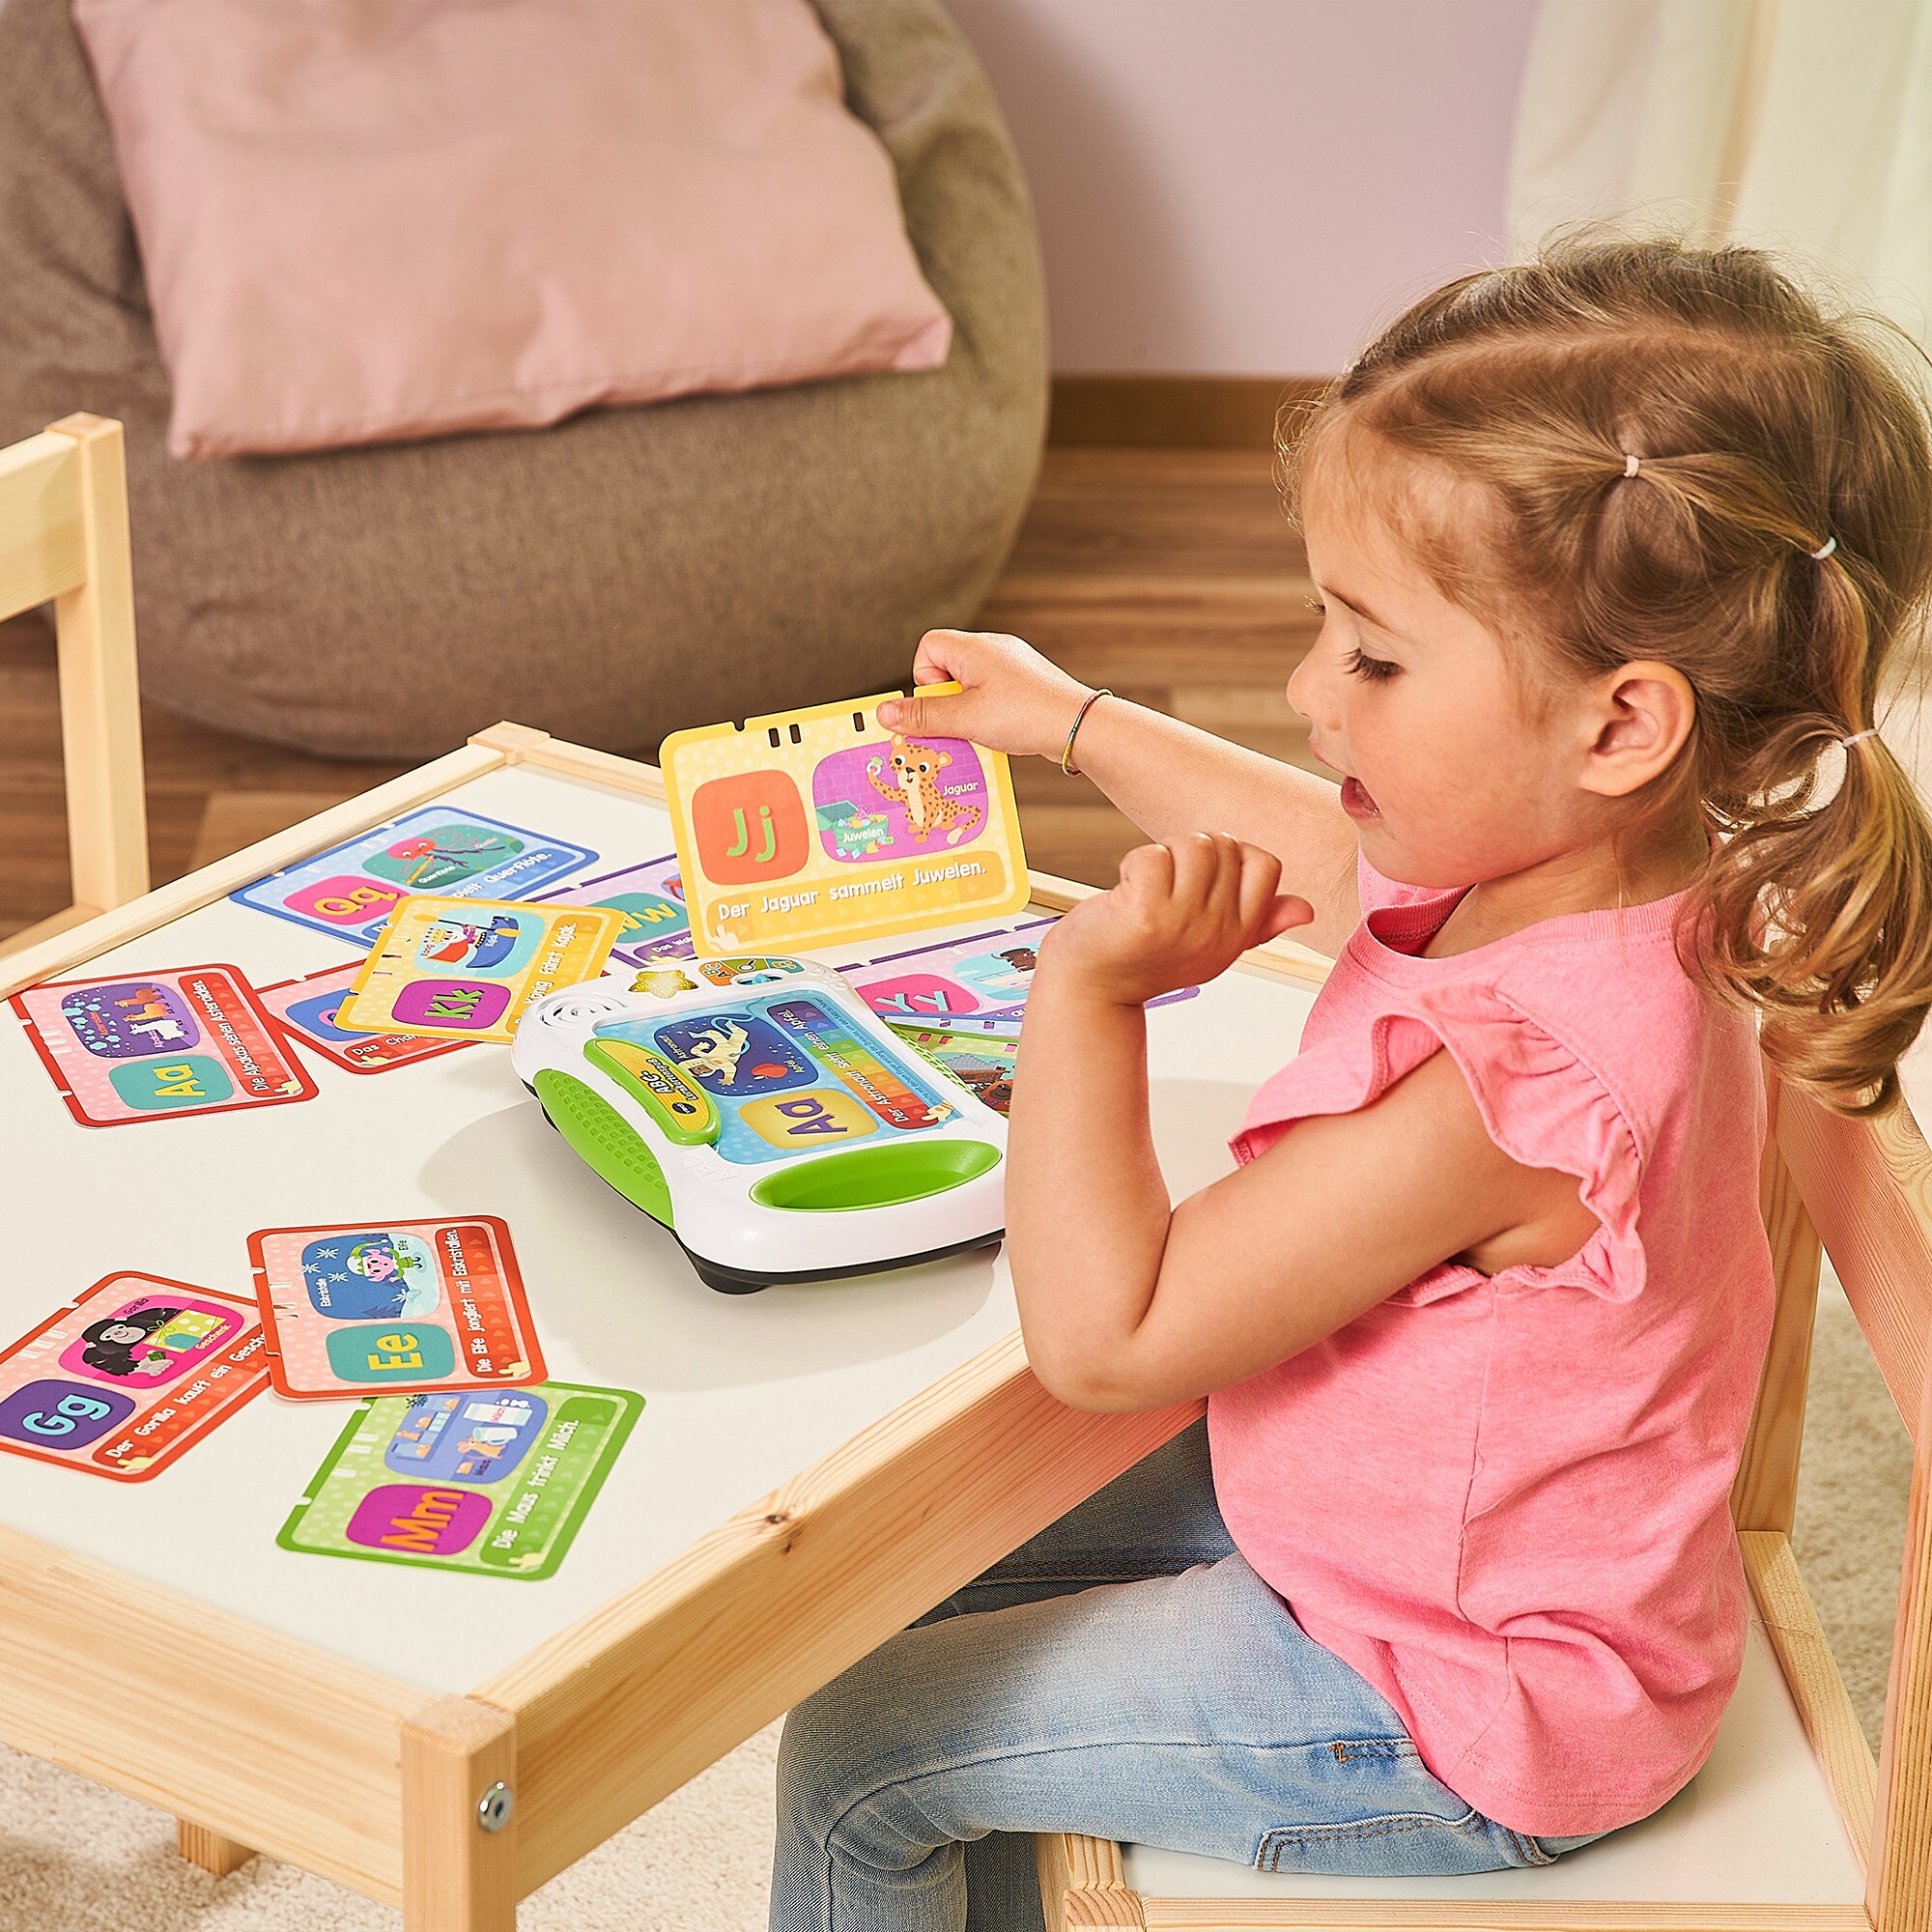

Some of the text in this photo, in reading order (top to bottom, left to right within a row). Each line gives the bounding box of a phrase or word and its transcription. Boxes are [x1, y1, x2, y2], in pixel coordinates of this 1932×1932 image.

[942, 781, 979, 797] Jaguar
[726, 806, 777, 863] Jj
[841, 828, 884, 843] Juwelen
[448, 882, 483, 897] pielt
[484, 852, 552, 883] Querflöte.
[314, 886, 398, 916] Qq
[718, 860, 986, 921] Der Jaguar sammelt Juwelen.
[551, 923, 578, 948] Kajak.
[652, 943, 673, 953] Das
[539, 952, 564, 975] fährt
[424, 989, 483, 1019] Kk
[192, 980, 270, 1091] Die Alpakas sehen Asteroiden.
[352, 1043, 381, 1055] Das
[658, 1035, 689, 1059] Astronaut
[804, 1032, 830, 1050] einen
[782, 1060, 805, 1073] Apfel
[824, 1052, 850, 1068] sieht
[153, 1064, 206, 1096] Aa
[845, 1069, 892, 1105] Astronaut
[775, 1098, 848, 1134] Aa
[888, 1108, 910, 1122] Der
[398, 1239, 409, 1251] Elfe
[124, 1298, 149, 1315] Gorilla
[316, 1277, 331, 1307] Eiskristalle
[445, 1229, 493, 1373] Die Elfe jongliert mit Eiskristallen.
[195, 1324, 232, 1349] Geschenk
[367, 1332, 424, 1371] Ee
[105, 1333, 266, 1458] Der Gorilla kauft ein Gesch
[22, 1394, 111, 1435] Gg
[491, 1420, 580, 1548] Die Maus trinkt Milch.
[380, 1491, 465, 1552] Mm
